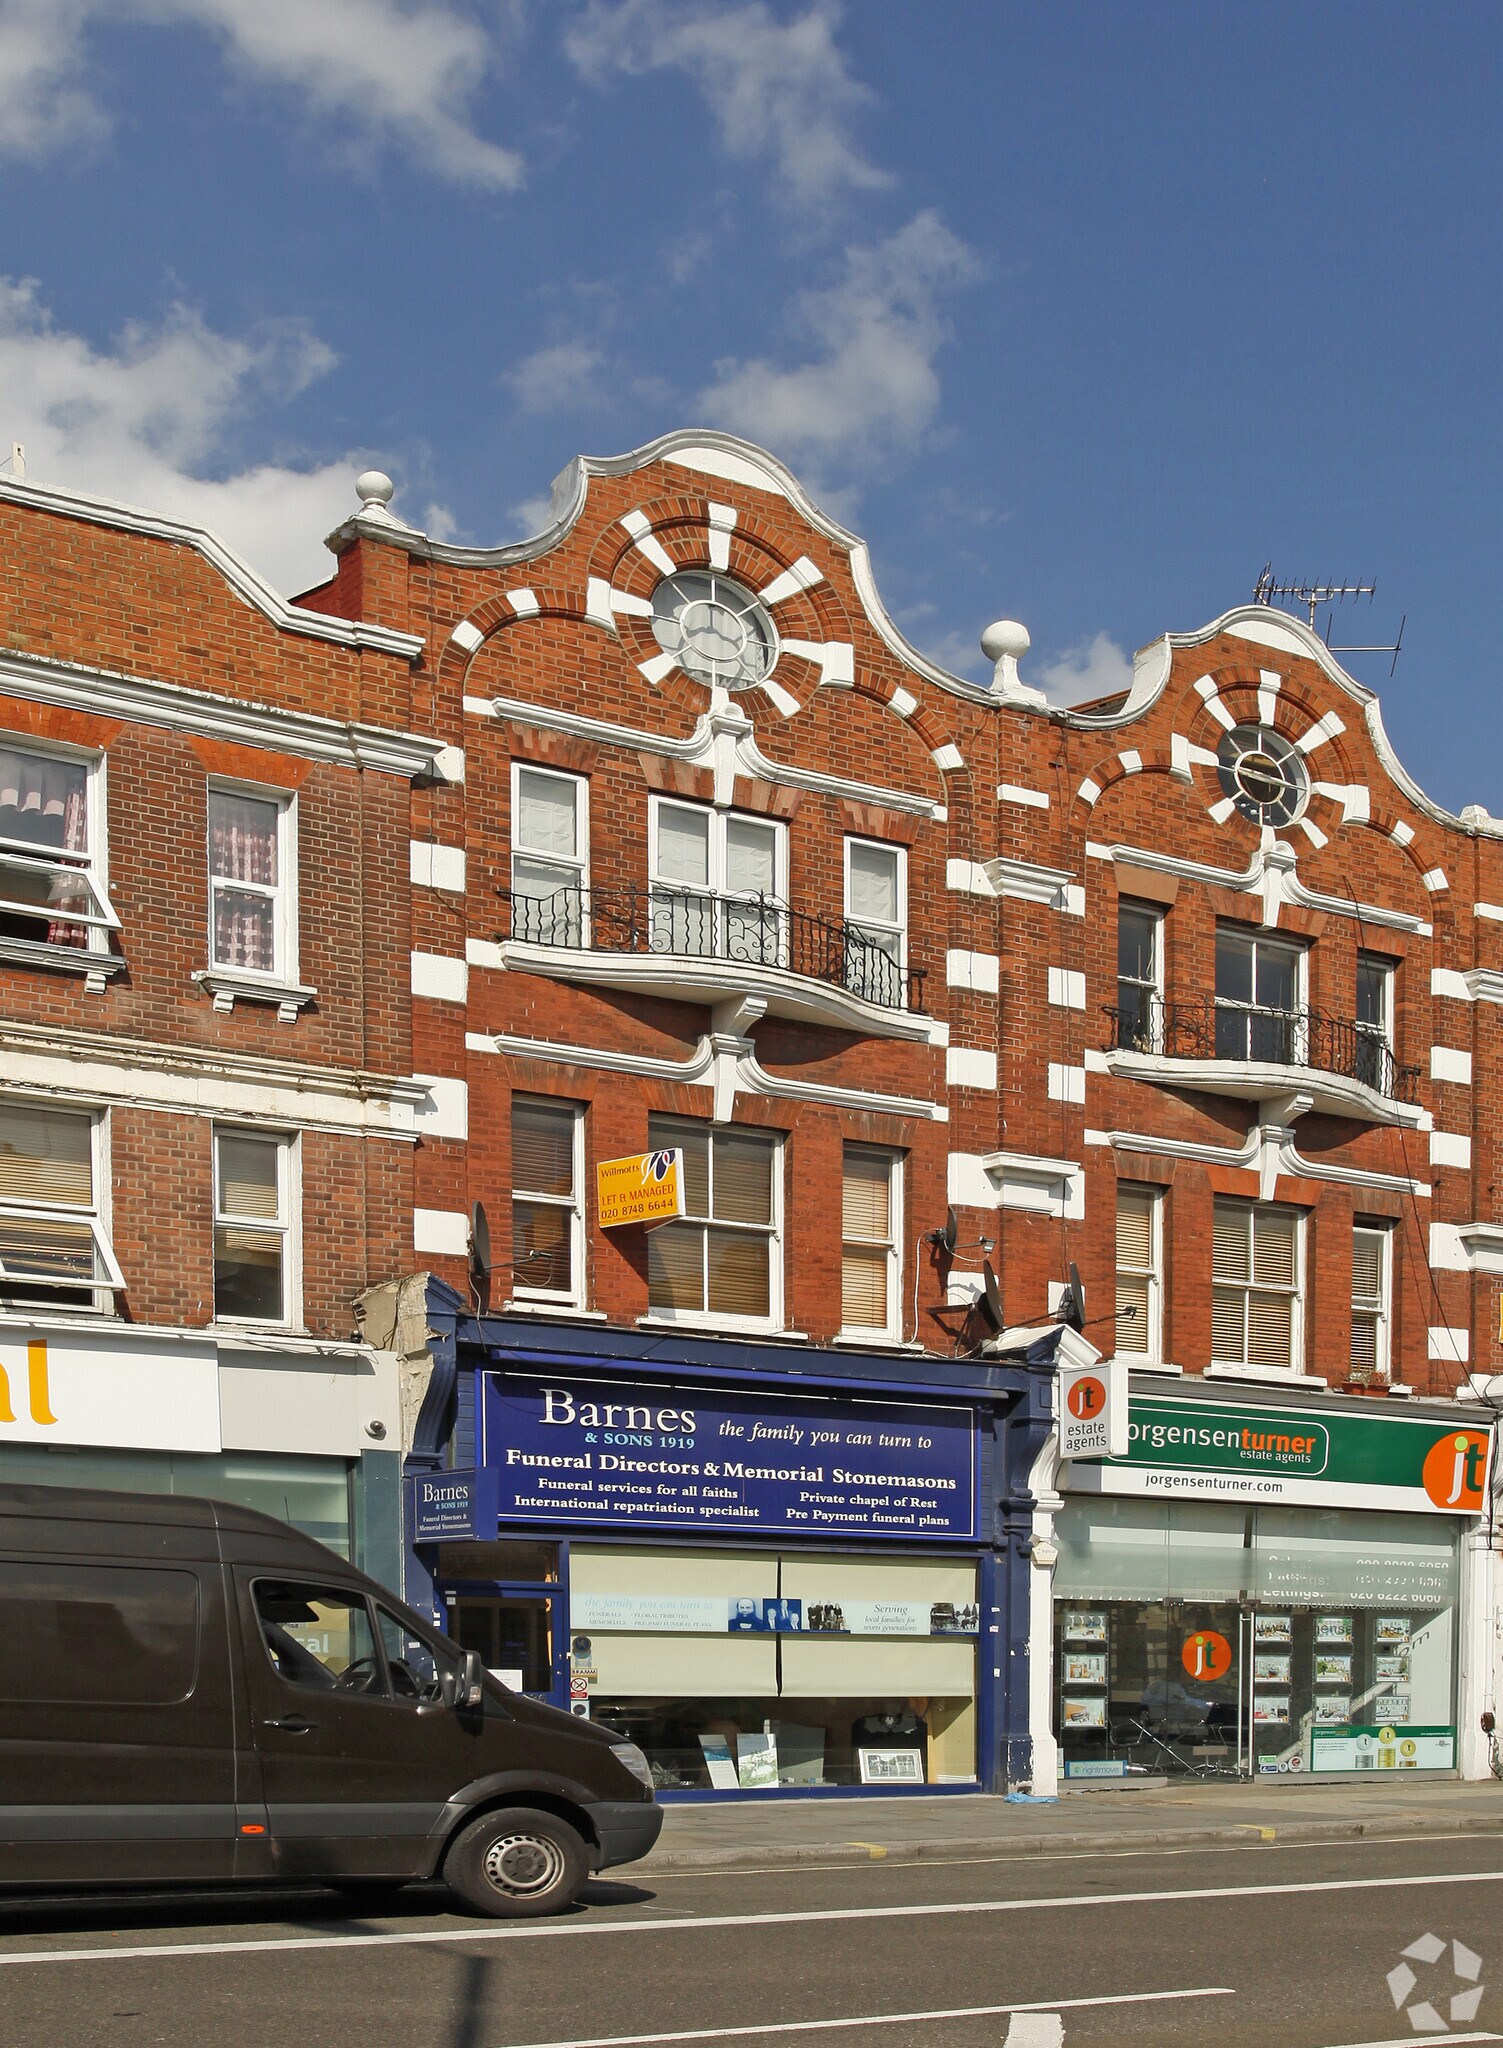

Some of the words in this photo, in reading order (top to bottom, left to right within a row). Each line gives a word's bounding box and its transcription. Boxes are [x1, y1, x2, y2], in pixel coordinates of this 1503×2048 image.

[601, 1164, 640, 1178] Willmotts
[602, 1194, 617, 1207] LET
[619, 1194, 627, 1203] &
[629, 1184, 674, 1200] MANAGED
[601, 1208, 618, 1220] 020
[622, 1203, 644, 1215] 8748
[648, 1199, 674, 1211] 6644
[1077, 1383, 1095, 1416] jt
[539, 1388, 697, 1434] Barnes
[719, 1419, 744, 1438] the
[746, 1421, 804, 1445] family
[810, 1430, 840, 1446] you
[846, 1432, 873, 1445] can
[879, 1433, 912, 1448] turn
[917, 1436, 932, 1449] to
[1068, 1422, 1105, 1436] estate
[585, 1432, 598, 1443] &
[603, 1433, 653, 1447] SONS
[660, 1436, 695, 1450] 1919
[1066, 1435, 1107, 1452] agents
[1240, 1450, 1272, 1461] estate
[1275, 1451, 1311, 1464] agents
[506, 1449, 592, 1469] Funeral
[599, 1453, 700, 1476] Directors
[703, 1462, 720, 1477] &
[723, 1462, 824, 1482] Memorial
[832, 1467, 957, 1491] Stonemasons
[1447, 1436, 1485, 1505] jt
[538, 1477, 593, 1491] Funeral
[597, 1482, 653, 1495] services
[656, 1483, 678, 1496] for
[681, 1485, 698, 1497] all
[701, 1486, 739, 1499] faiths
[1145, 1472, 1283, 1493] jorgensenturner.com
[423, 1483, 468, 1502] Barnes
[800, 1491, 846, 1505] Private
[849, 1493, 890, 1508] chapel
[893, 1496, 909, 1508] of
[910, 1497, 938, 1509] Rest
[441, 1502, 456, 1510] SONS
[514, 1494, 609, 1511] International
[613, 1500, 695, 1516] repatriation
[699, 1503, 760, 1518] specialist
[419, 1523, 441, 1531] Memorial
[442, 1522, 471, 1530] Stonemasons
[786, 1508, 808, 1520] Pre
[812, 1509, 869, 1523] Payment
[872, 1511, 915, 1525] funeral
[918, 1514, 950, 1527] plans
[585, 1597, 601, 1608] the
[603, 1598, 634, 1610] family
[638, 1600, 657, 1610] you
[680, 1601, 701, 1609] turn
[703, 1601, 712, 1610] to
[873, 1604, 908, 1616] Serving
[881, 1616, 905, 1625] families
[906, 1617, 916, 1626] for
[1194, 1635, 1216, 1676] jt
[1081, 1765, 1120, 1775] rightmove
